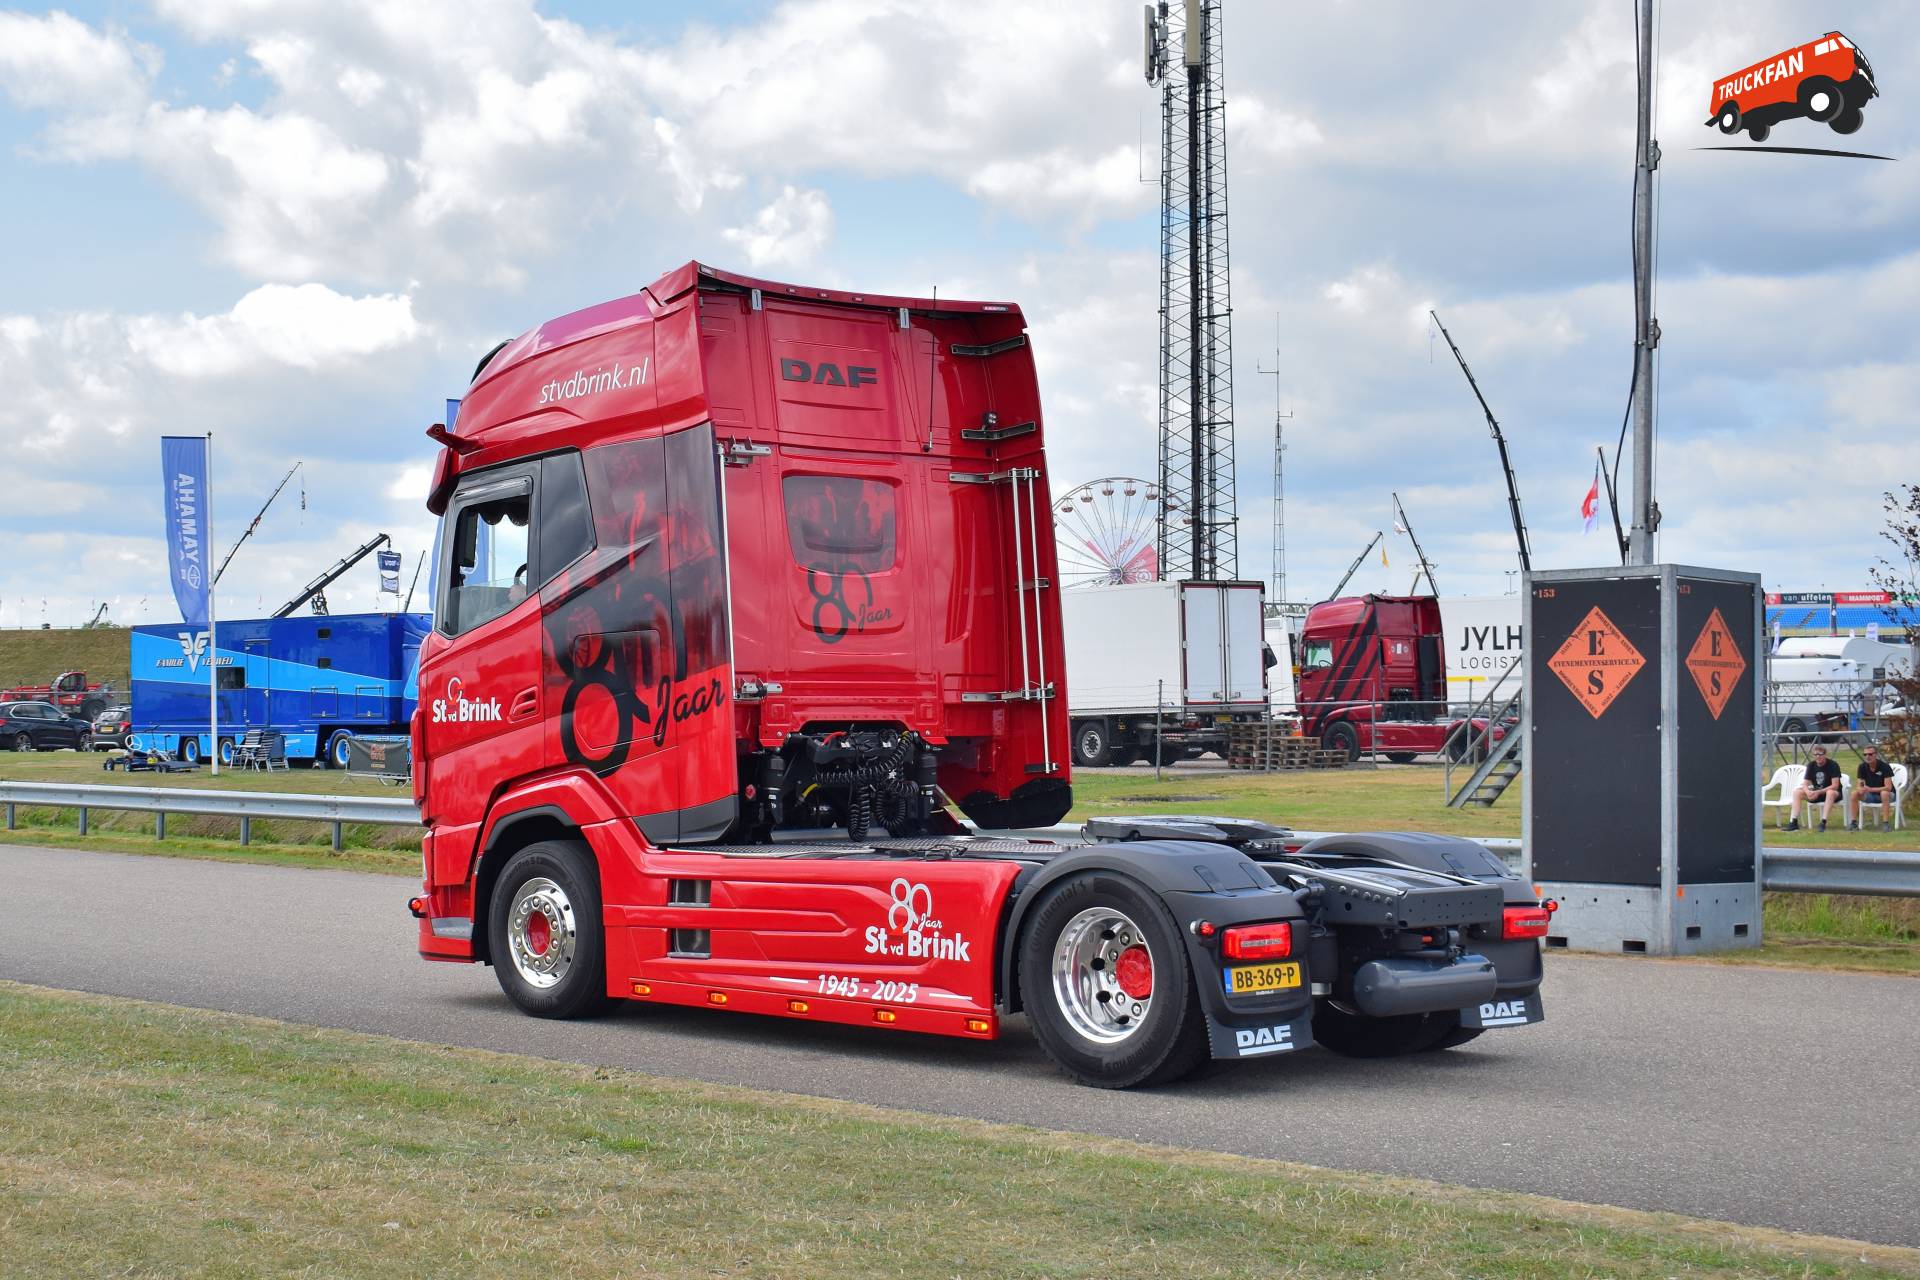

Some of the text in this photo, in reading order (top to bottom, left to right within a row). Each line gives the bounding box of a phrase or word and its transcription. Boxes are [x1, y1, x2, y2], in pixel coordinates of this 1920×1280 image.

[540, 357, 649, 404] stvdbrink.nl
[780, 357, 878, 389] DAF
[807, 561, 873, 645] 80
[1538, 588, 1556, 599] 153
[1800, 592, 1832, 601] uffelen
[857, 603, 893, 633] Jaar
[1587, 630, 1605, 656] E
[1710, 630, 1722, 657] E
[1587, 669, 1605, 696] S
[1710, 670, 1722, 697] S
[432, 696, 503, 723] St vd Brink
[653, 674, 726, 747] Jaar
[888, 877, 932, 934] 80
[918, 912, 943, 932] Jaar
[864, 925, 971, 962] St vd Brink
[818, 974, 860, 998] 1945
[871, 979, 919, 1003] 2025
[1235, 966, 1295, 989] BB-369-P
[1480, 1000, 1526, 1019] DAF
[1235, 1024, 1292, 1048] DAF
